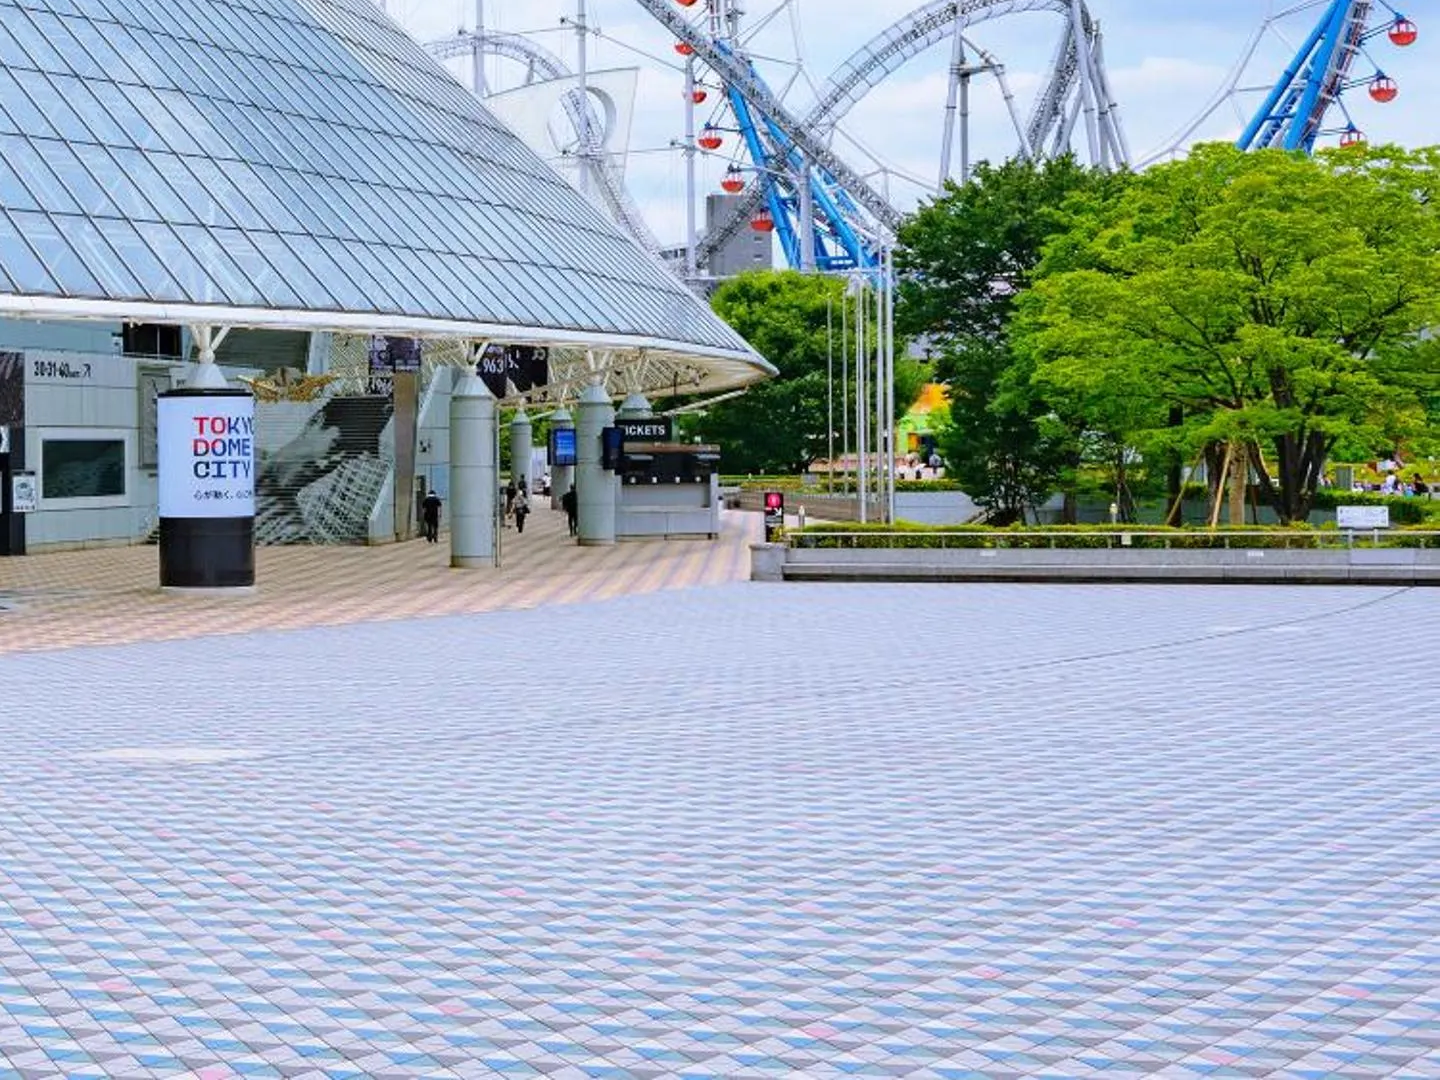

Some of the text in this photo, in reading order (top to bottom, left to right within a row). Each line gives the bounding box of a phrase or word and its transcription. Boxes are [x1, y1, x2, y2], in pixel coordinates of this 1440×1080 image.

[479, 357, 505, 374] 963
[193, 438, 251, 457] DOME
[193, 461, 251, 478] CITY
